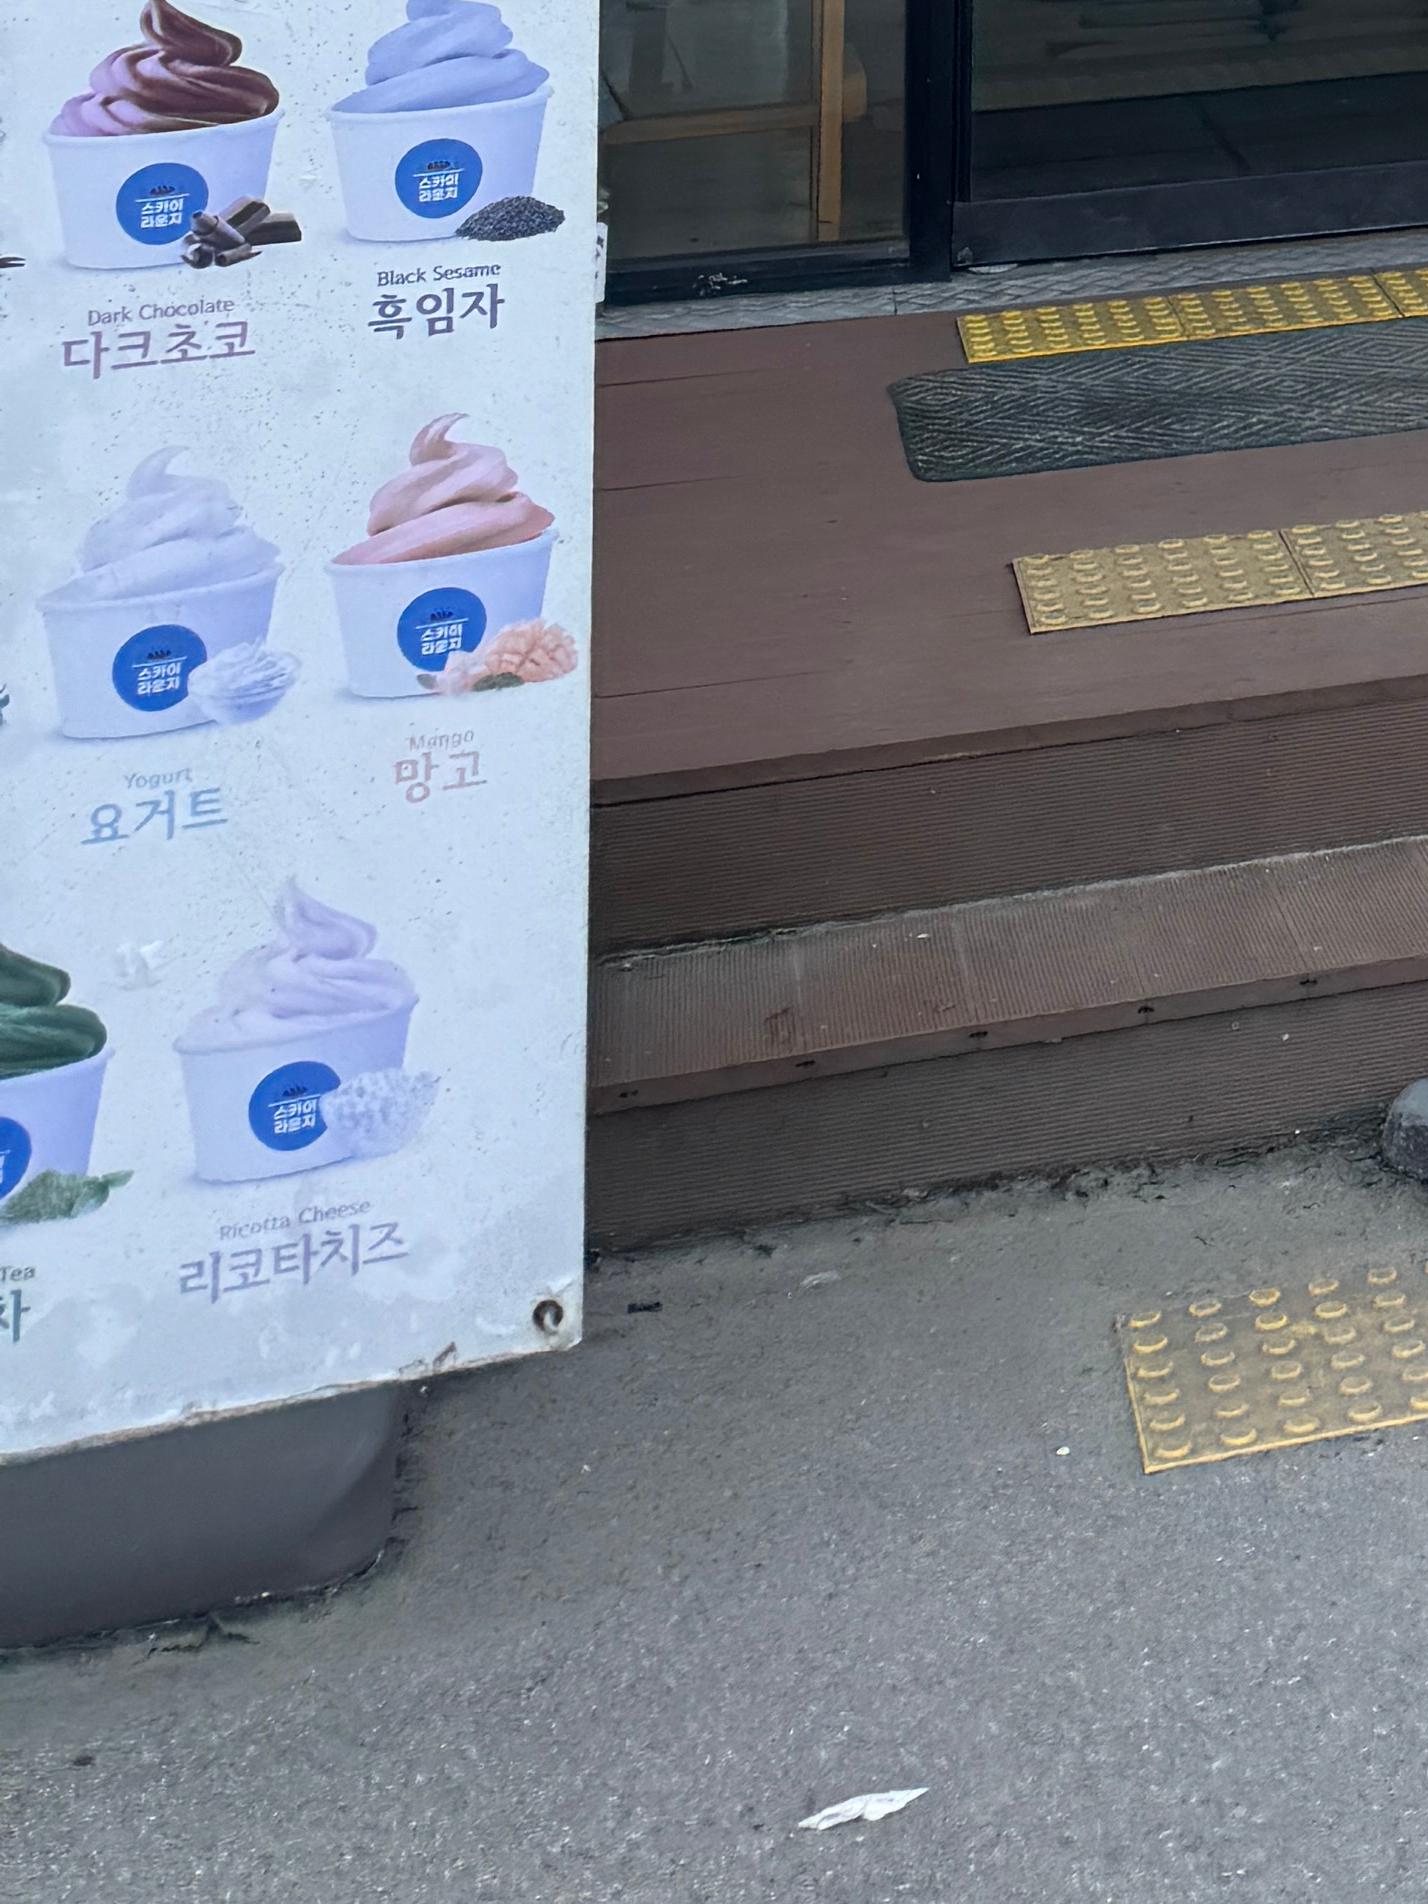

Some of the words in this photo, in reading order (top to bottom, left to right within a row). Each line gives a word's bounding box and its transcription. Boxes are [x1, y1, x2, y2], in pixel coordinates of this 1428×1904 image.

[376, 267, 427, 288] Black
[432, 262, 503, 283] Sesame
[87, 307, 132, 326] Dark
[139, 296, 235, 320] Chocolate
[367, 283, 506, 341] 흑임자
[62, 320, 256, 380] 다크초코
[123, 767, 194, 791] Yogurt
[392, 749, 488, 804] 망고
[79, 786, 229, 846] 요거트
[218, 1212, 291, 1241] Ricotta
[298, 1198, 371, 1224] Cheese
[178, 1221, 409, 1305] 리코타치즈
